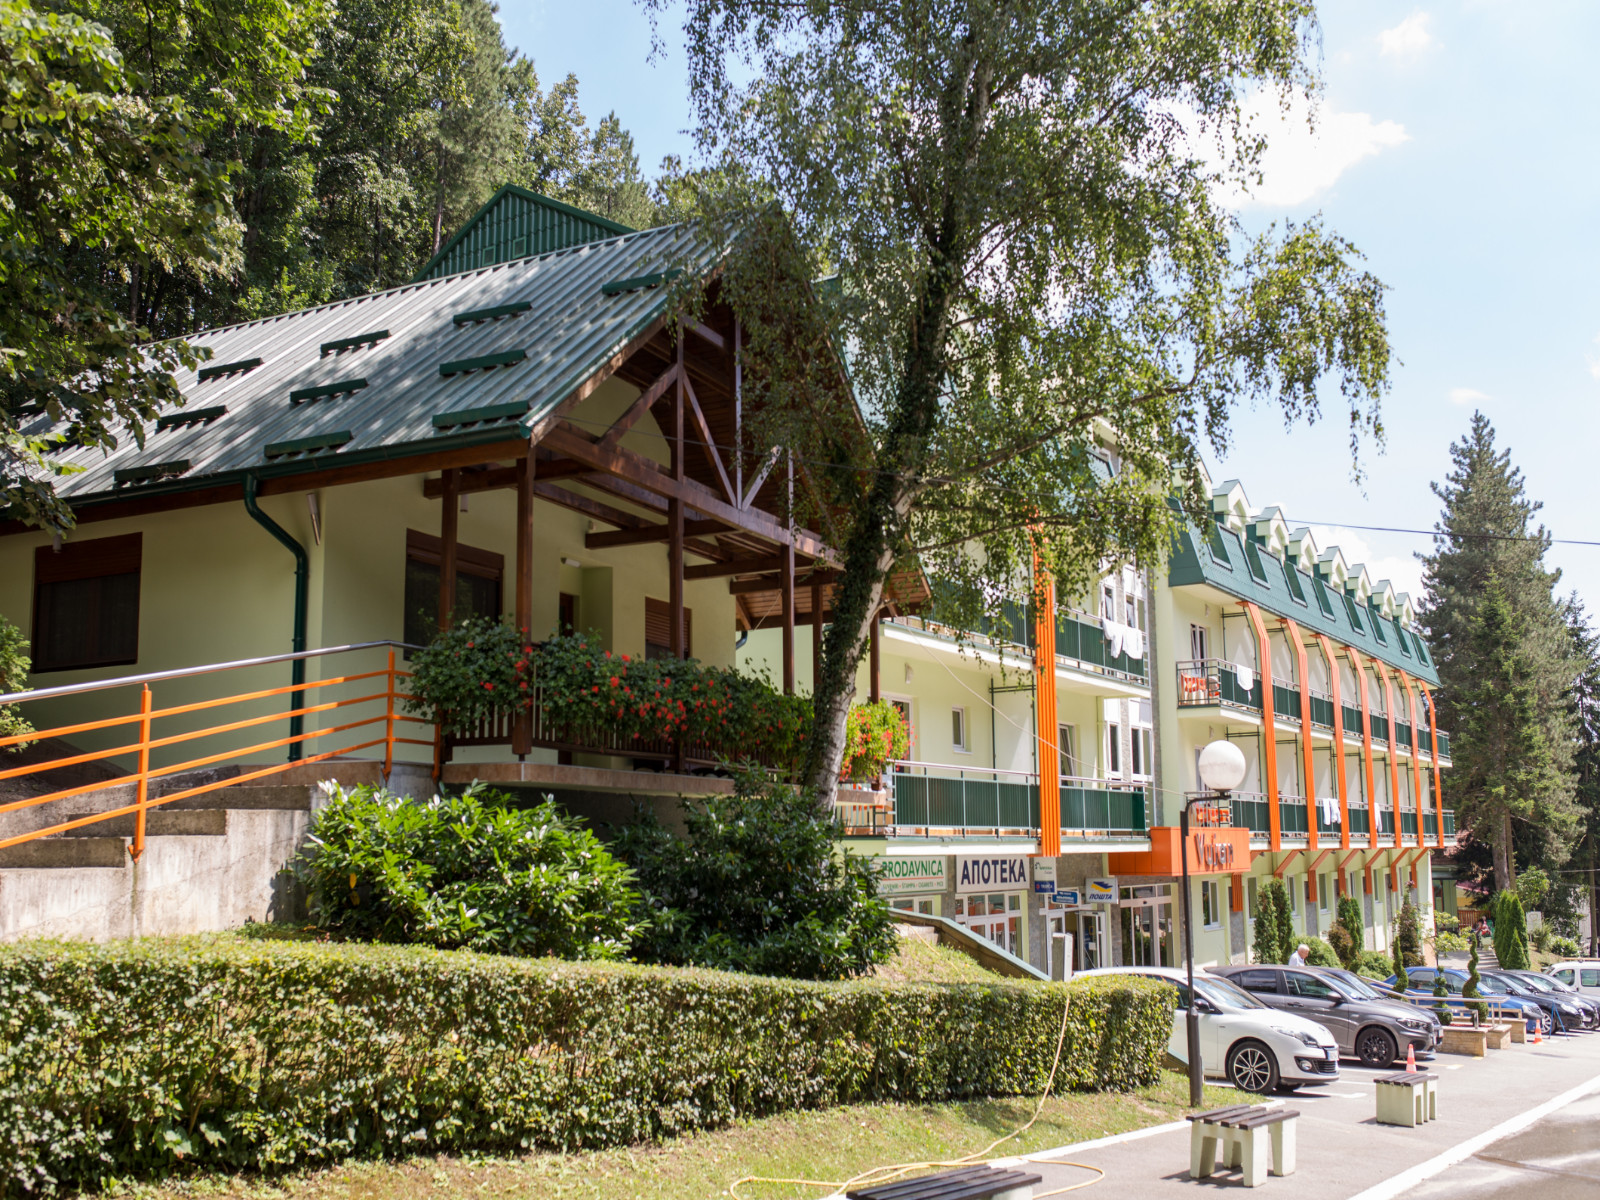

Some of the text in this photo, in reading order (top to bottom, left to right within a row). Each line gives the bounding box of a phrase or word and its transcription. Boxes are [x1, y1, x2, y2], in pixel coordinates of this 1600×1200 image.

[1194, 833, 1233, 867] Vujan
[881, 860, 943, 877] PRODAVNICA
[961, 859, 1026, 885] АПОТЕКА
